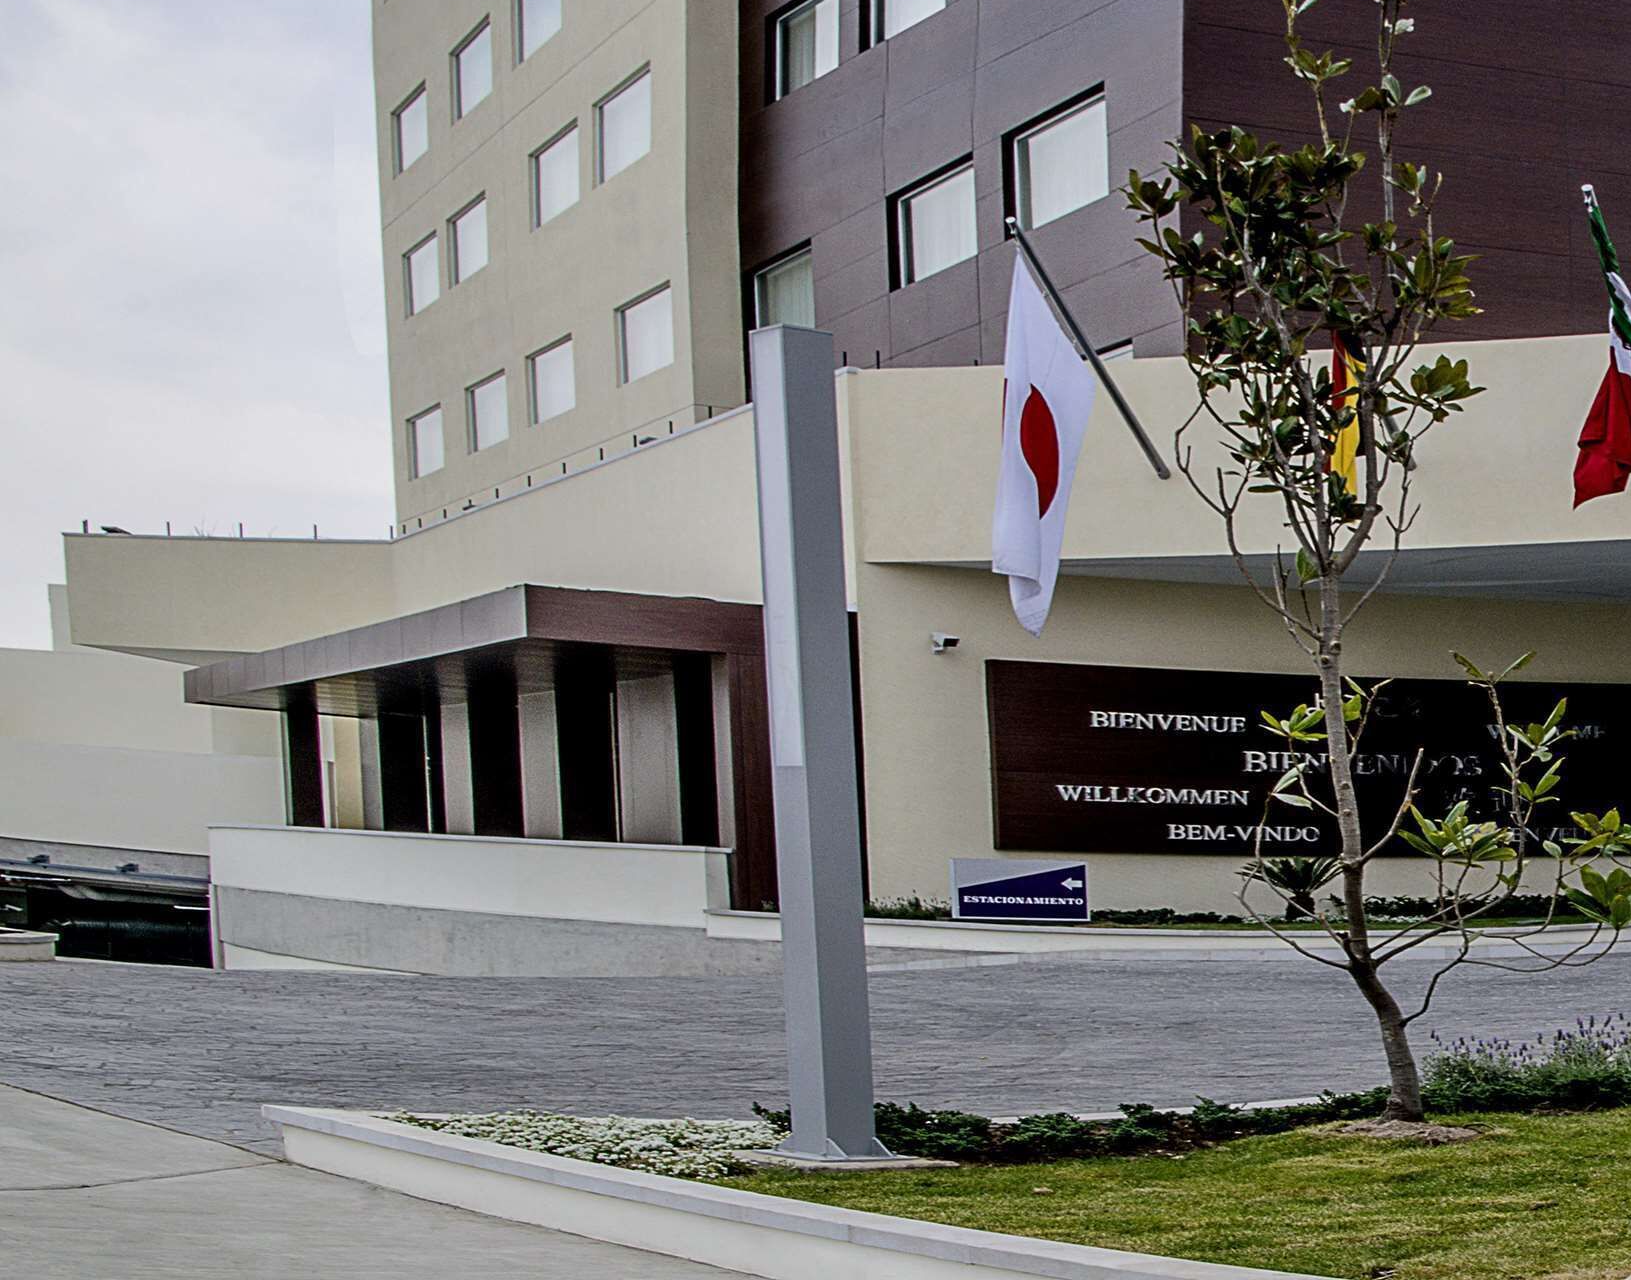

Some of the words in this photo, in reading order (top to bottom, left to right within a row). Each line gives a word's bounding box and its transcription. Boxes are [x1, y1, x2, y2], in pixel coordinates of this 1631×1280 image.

[1089, 710, 1247, 733] BIENVENUE
[1056, 784, 1249, 806] WILLKOMMEN
[963, 895, 1084, 906] ESTACIONAMIENTO
